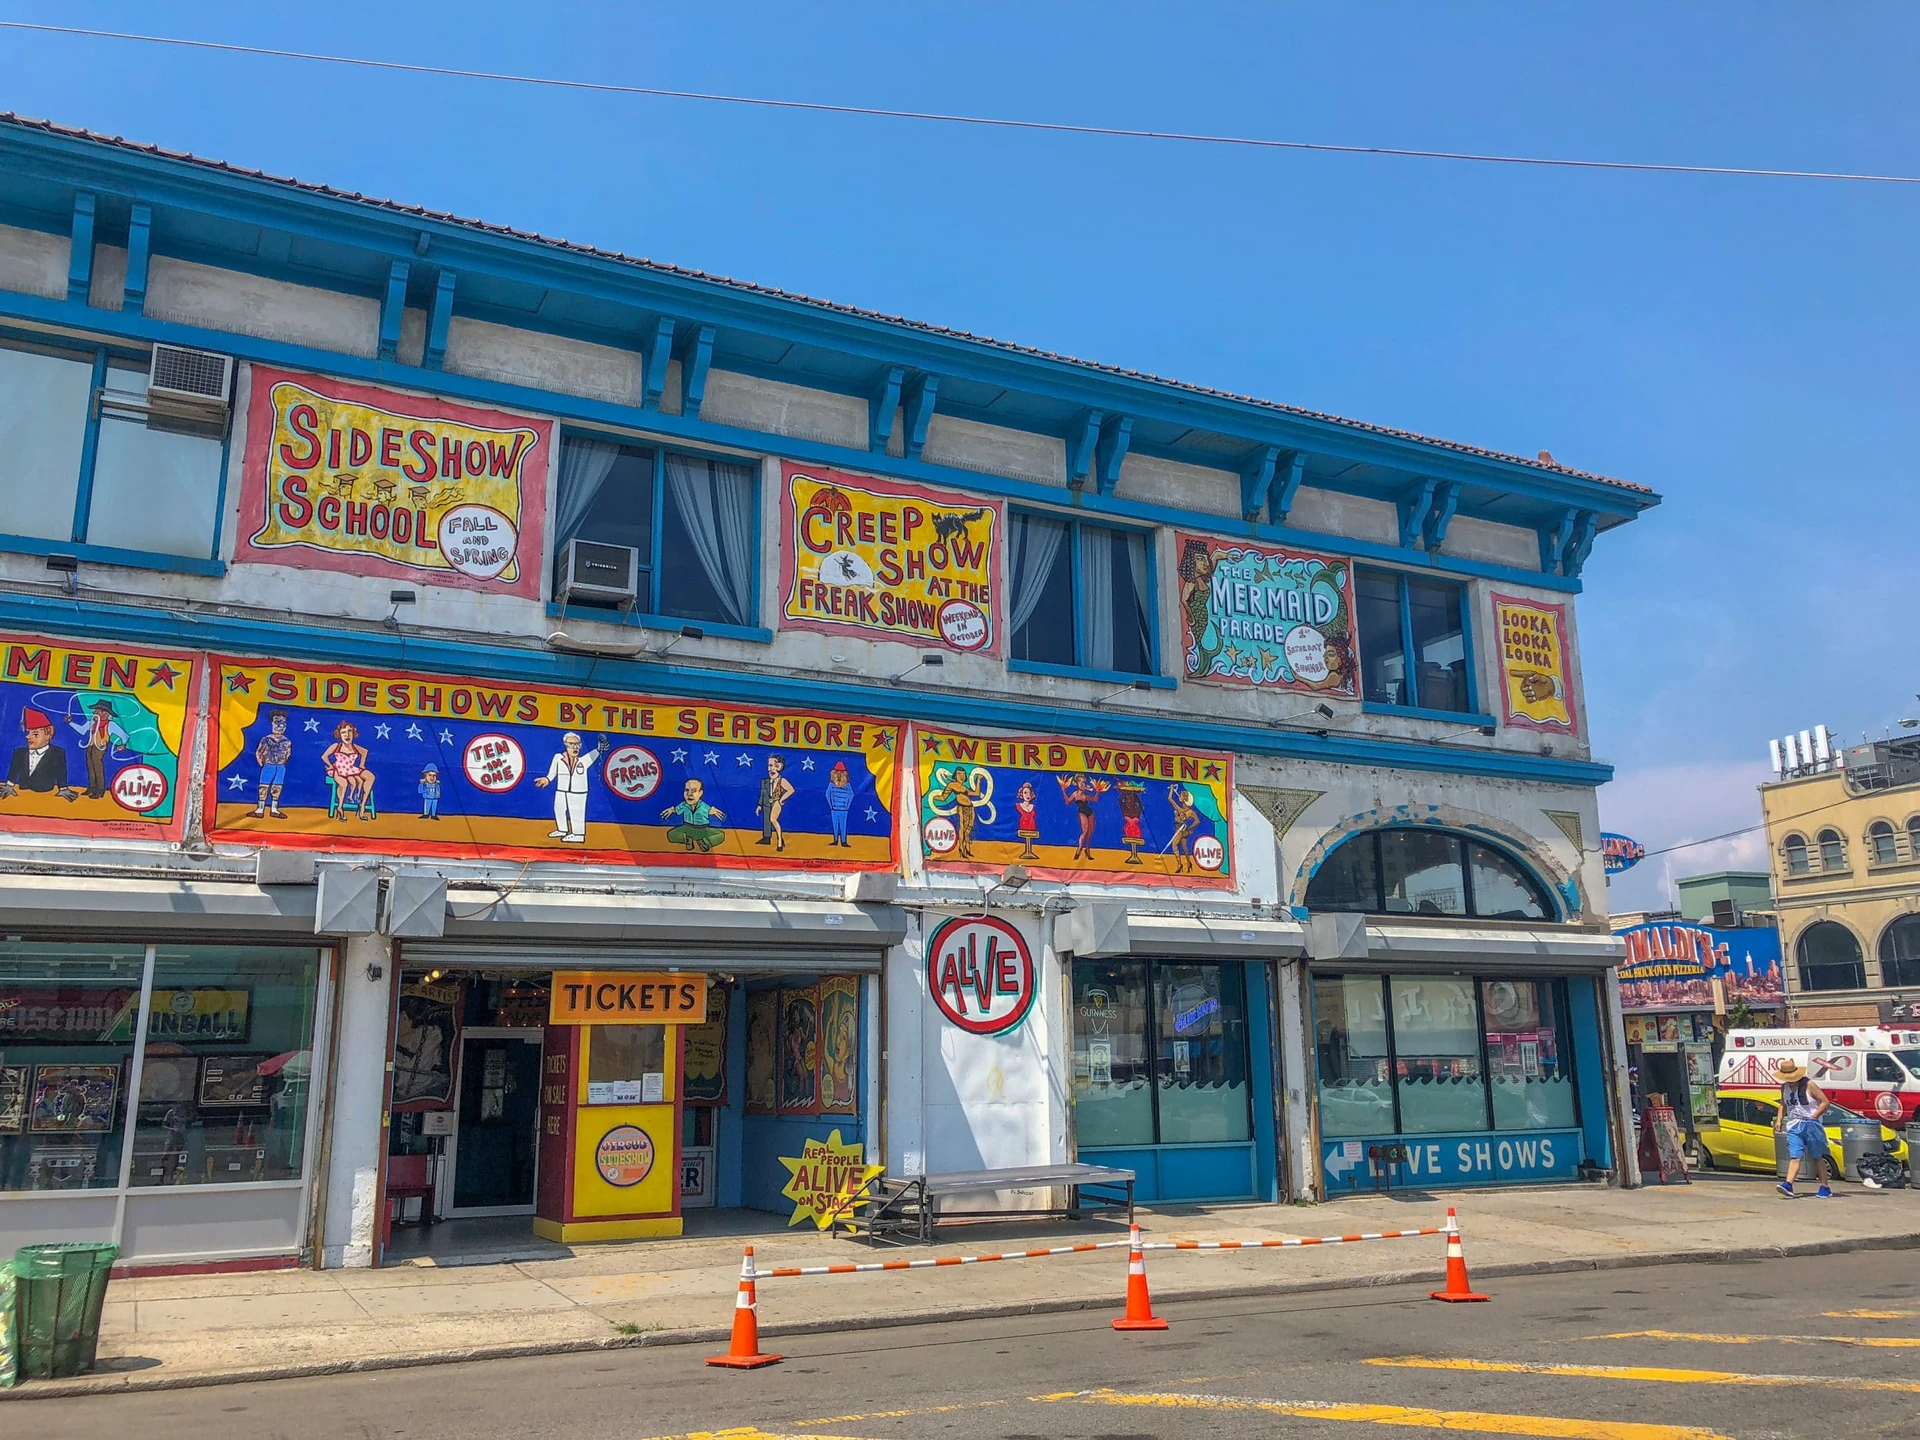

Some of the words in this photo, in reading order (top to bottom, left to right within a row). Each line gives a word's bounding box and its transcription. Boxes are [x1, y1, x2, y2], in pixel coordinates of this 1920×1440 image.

[279, 403, 525, 482] SIDESHOW
[279, 475, 437, 549] SCHOOL
[449, 516, 497, 534] FALL
[801, 506, 924, 553] CREEP
[463, 536, 489, 546] AND
[450, 546, 510, 567] SPRING
[877, 538, 985, 586] SHOW
[1219, 566, 1250, 581] THE
[927, 576, 952, 597] AT
[956, 580, 989, 604] THE
[1211, 576, 1333, 626] MERMAID
[942, 610, 982, 624] WEEKENDS
[957, 622, 967, 631] IN
[1502, 610, 1551, 634] LOOKA
[950, 629, 984, 641] OCTOBER
[1219, 618, 1284, 645] PARADE
[1504, 629, 1552, 651] LOOKA
[1287, 643, 1322, 655] SATURDAY
[1505, 645, 1552, 668] LOOKA
[6, 646, 138, 688] MEN
[1295, 662, 1326, 673] SUMMER
[267, 671, 539, 722] SIDESHOWS
[559, 702, 593, 725] BY
[603, 705, 654, 731] THE
[678, 709, 865, 747] SEASHORE
[471, 740, 510, 761] TEN
[948, 738, 1067, 768] WEIRD
[1084, 750, 1199, 780] WOMEN
[481, 765, 514, 786] ONE
[610, 762, 658, 786] FREAKS
[116, 778, 161, 798] ALIVE
[927, 828, 955, 841] ALIVE
[1193, 847, 1222, 860] ALIVE
[941, 932, 1019, 1014] ALIVE
[1634, 966, 1672, 978] BRICK-OVEN
[1673, 964, 1706, 976] PIZZERIA
[421, 985, 459, 1001] ARTIST
[564, 983, 696, 1012] TICKETS
[1080, 1006, 1117, 1019] GUINNESS
[1760, 1037, 1810, 1047] AMBULANCE
[547, 1054, 566, 1073] TICKETS
[552, 1085, 566, 1104] SALE
[1652, 1109, 1674, 1122] BEER
[602, 1140, 648, 1151] CIRCUS
[804, 1144, 834, 1159] REAL
[820, 1155, 860, 1166] PEOPLE
[1458, 1139, 1556, 1173] SHOWS
[681, 1167, 699, 1188] R
[792, 1165, 865, 1194] ALIVE
[799, 1194, 813, 1207] ON
